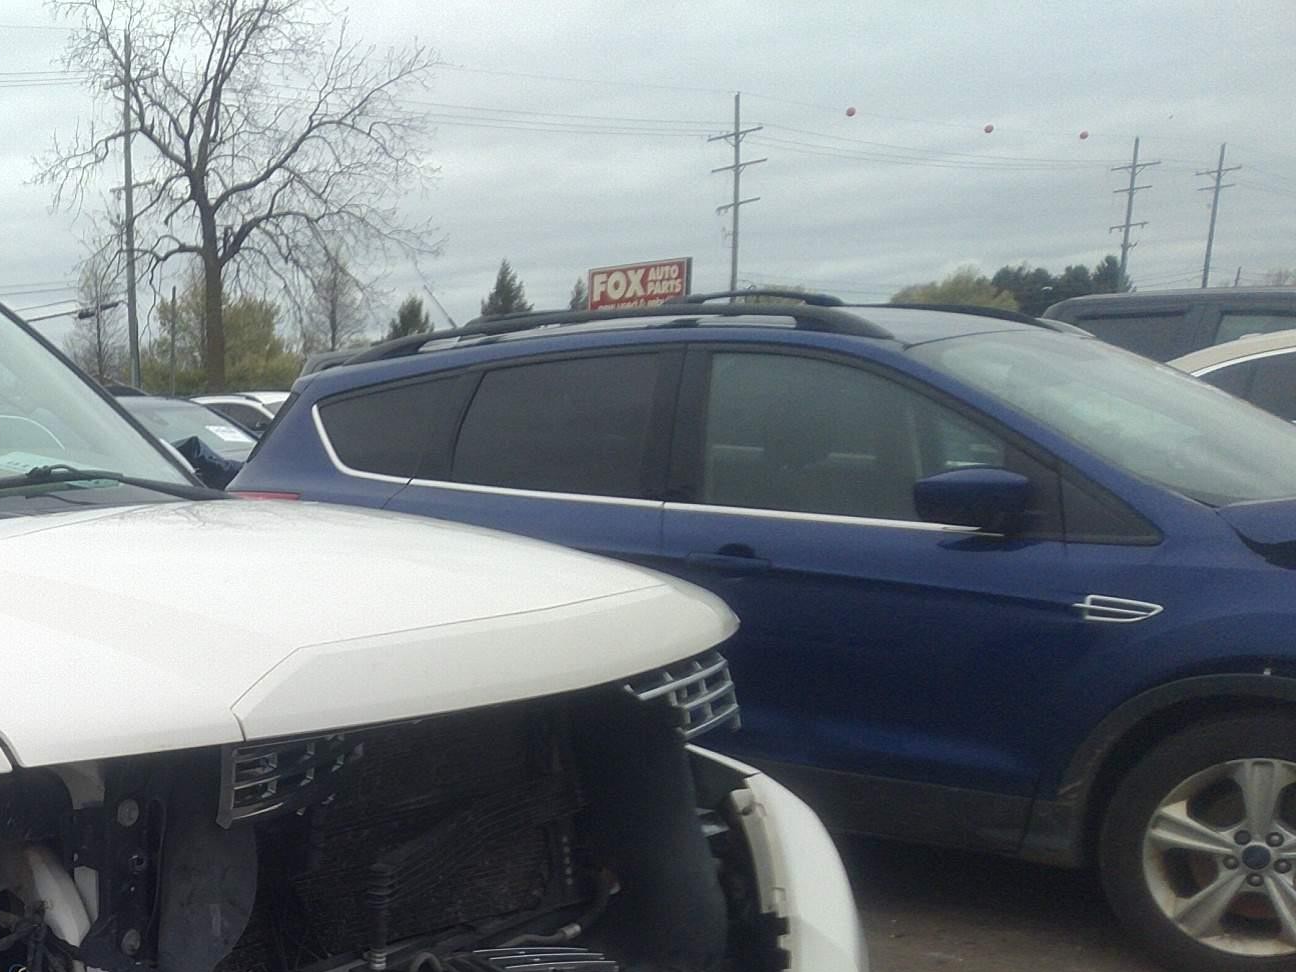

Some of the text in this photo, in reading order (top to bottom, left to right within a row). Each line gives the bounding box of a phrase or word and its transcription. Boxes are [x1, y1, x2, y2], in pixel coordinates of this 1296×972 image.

[648, 264, 679, 281] AUTO
[592, 268, 646, 303] FOX
[647, 279, 682, 295] PARTS
